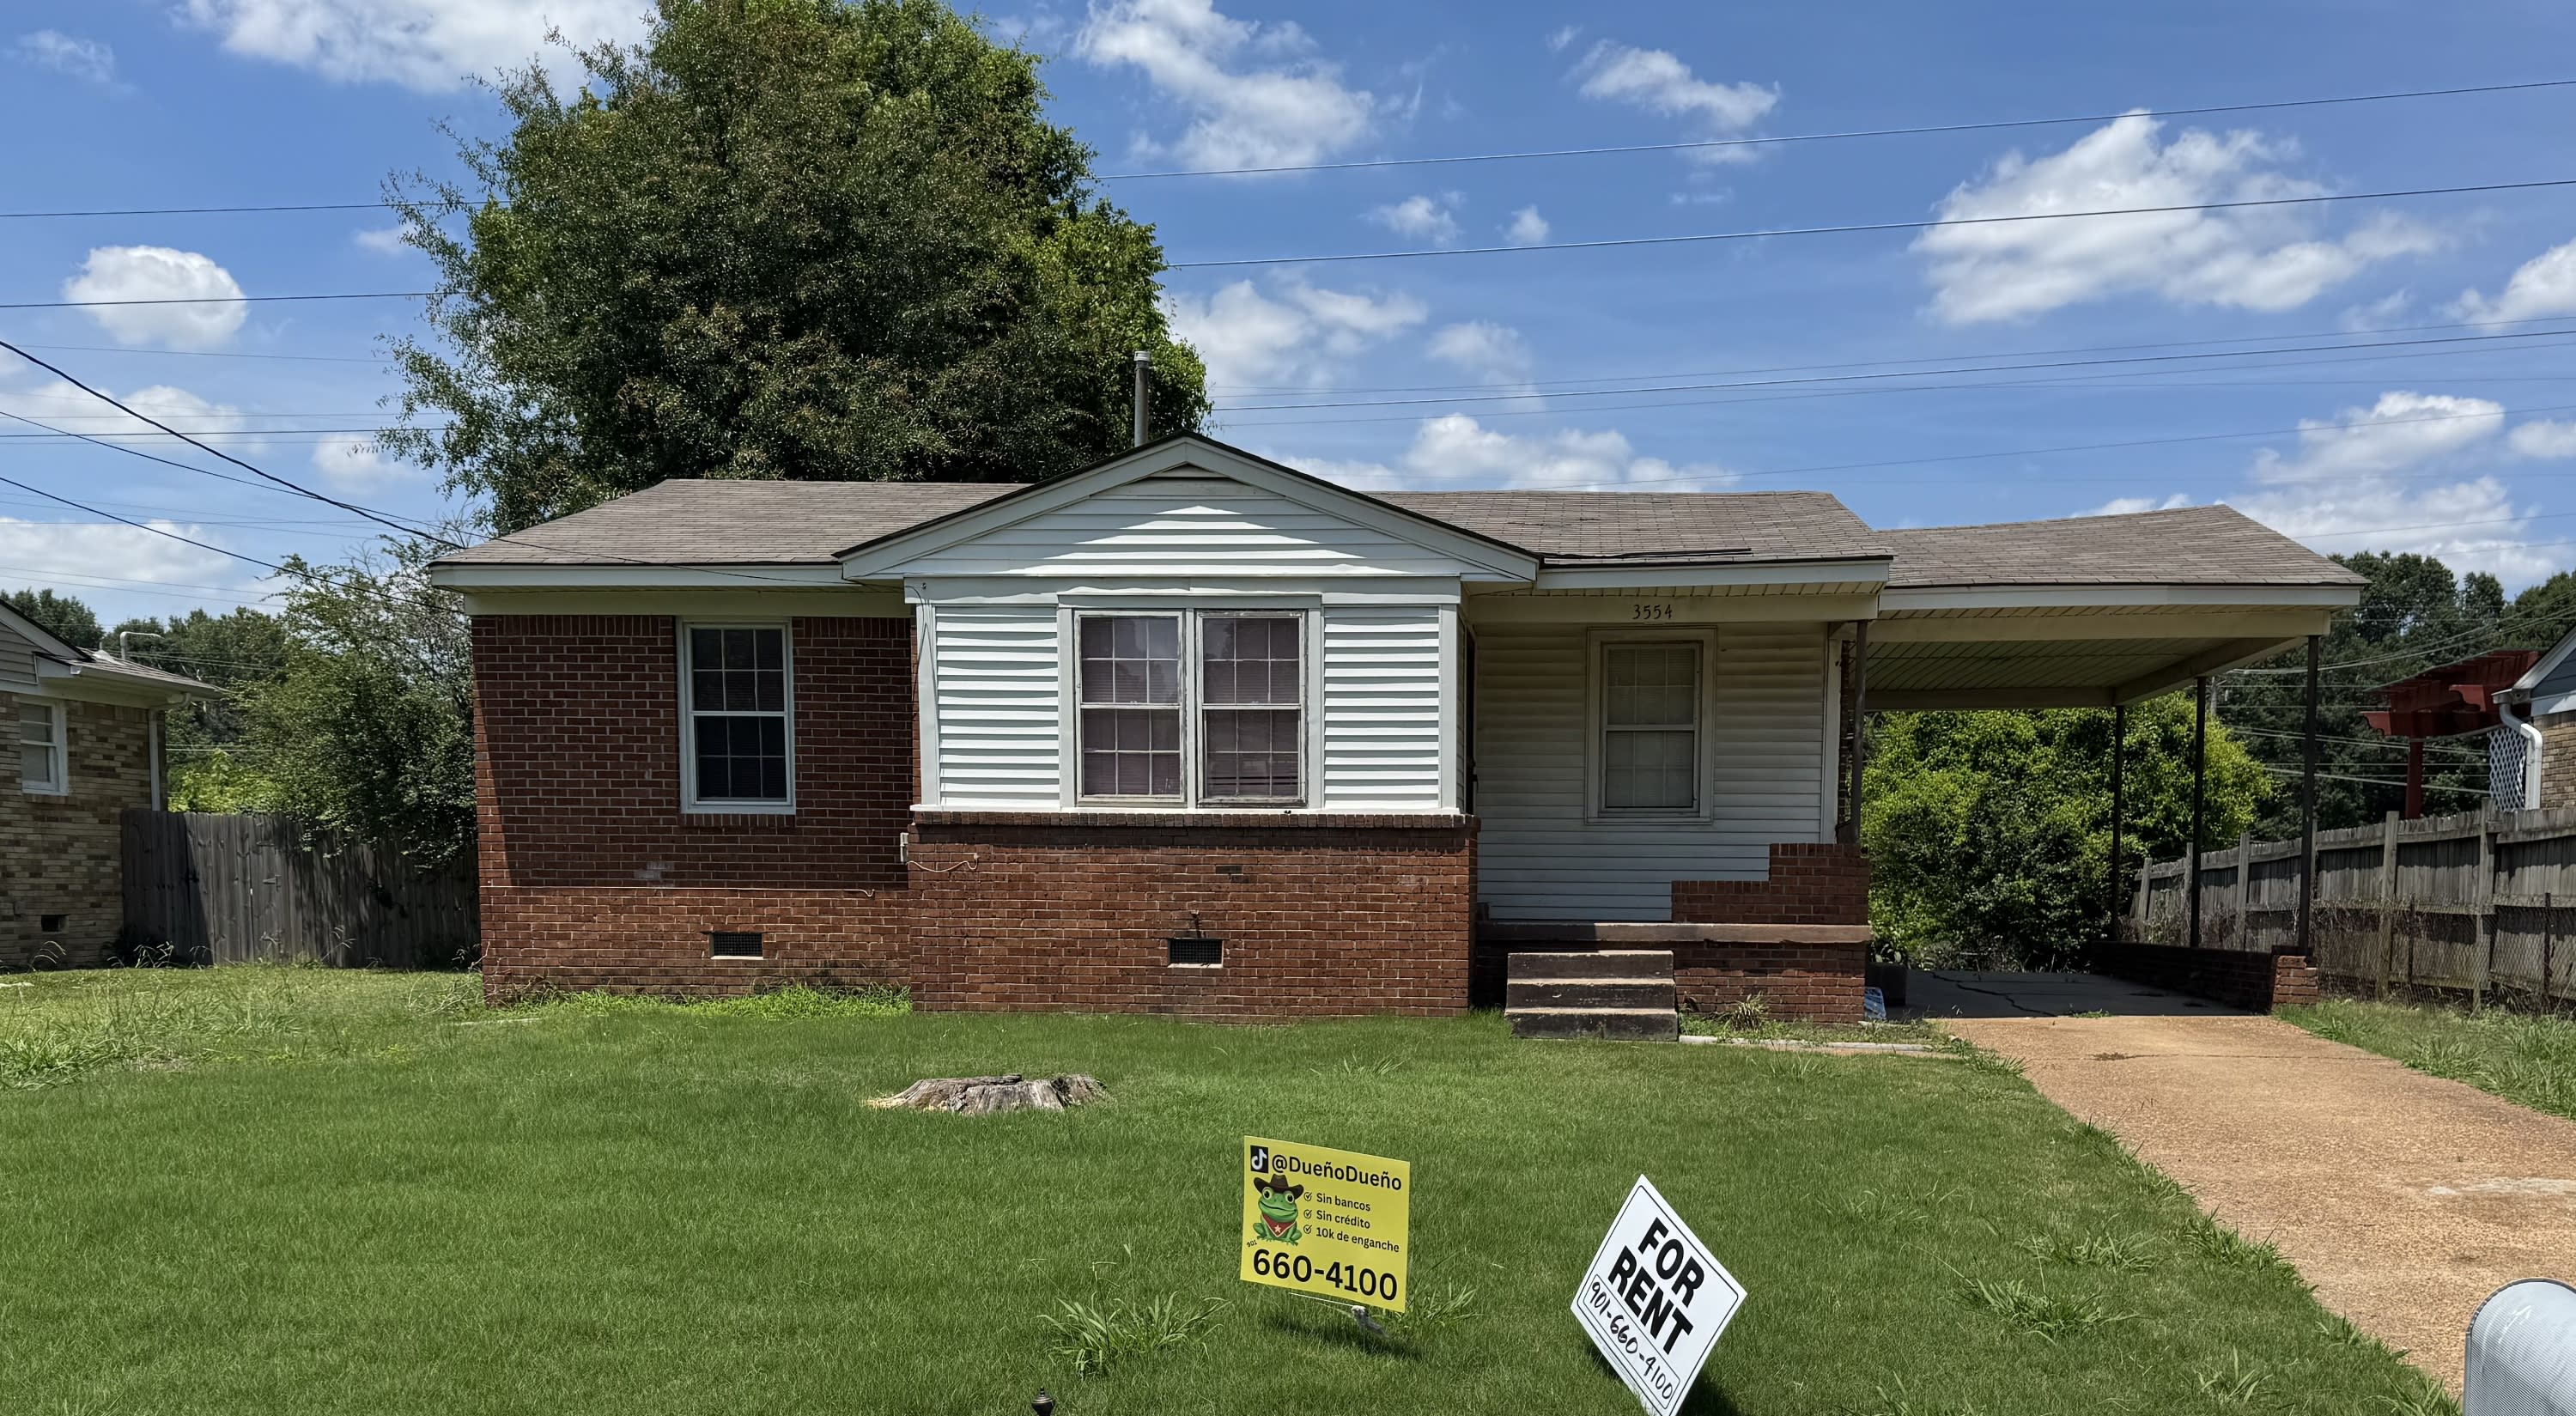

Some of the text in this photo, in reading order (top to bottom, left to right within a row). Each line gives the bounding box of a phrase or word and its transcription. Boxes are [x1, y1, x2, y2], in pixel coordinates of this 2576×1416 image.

[1632, 604, 1673, 619] 3554
[1272, 1154, 1402, 1191] @DueñoDueño
[1316, 1193, 1371, 1212] Sin bancos
[1316, 1210, 1370, 1229] Sin crédito
[1316, 1227, 1400, 1252] 10k de enganche
[1253, 1249, 1398, 1301] 660-4100
[1637, 1217, 1704, 1308] FOR
[1607, 1245, 1694, 1355] RENT
[1589, 1281, 1674, 1400] 901-660-4100
